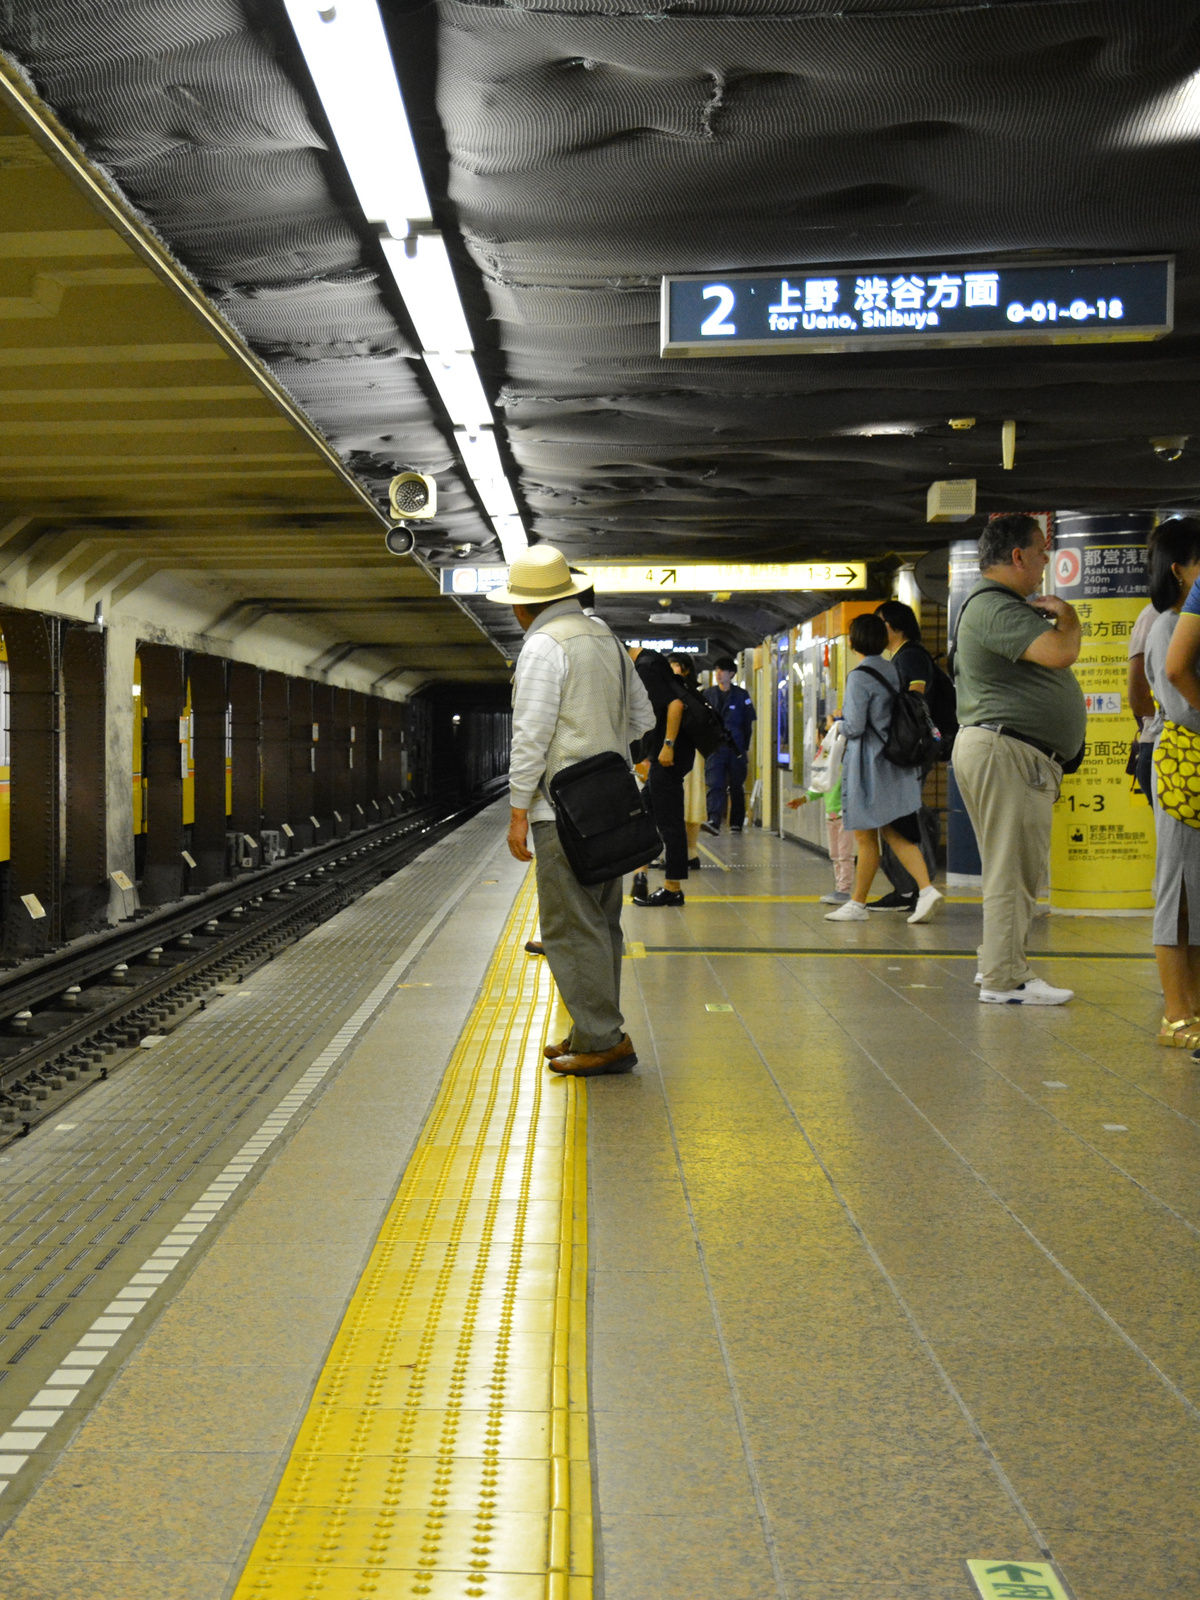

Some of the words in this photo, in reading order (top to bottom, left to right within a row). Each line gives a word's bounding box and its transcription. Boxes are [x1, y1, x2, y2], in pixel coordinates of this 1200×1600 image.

[768, 279, 839, 314] 上野
[854, 273, 1000, 311] 渋谷方面
[700, 284, 736, 336] 2
[768, 313, 798, 331] for
[802, 312, 857, 331] Ueno,
[862, 308, 939, 330] Shibuya
[1061, 561, 1070, 574] A
[1084, 566, 1124, 575] Asakusa
[1127, 565, 1144, 574] Line
[645, 569, 654, 582] 4
[1084, 576, 1110, 584] 240m
[1068, 795, 1105, 812] 1~3
